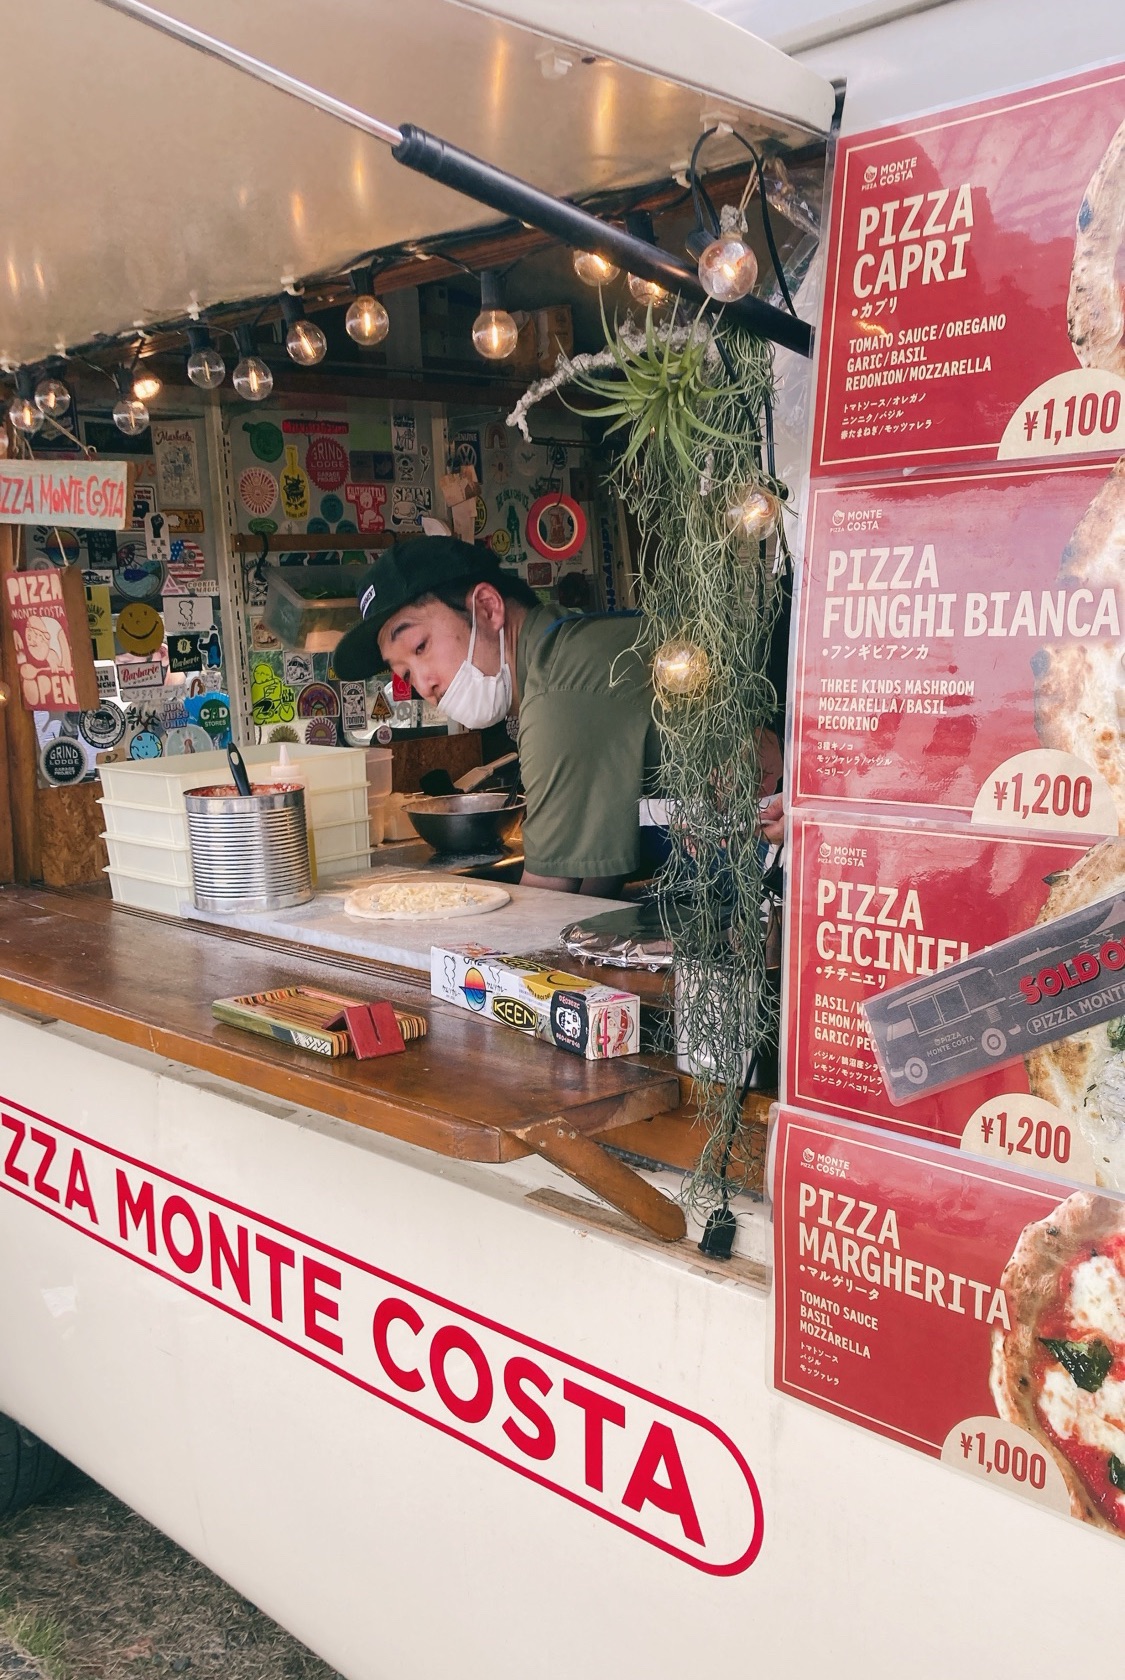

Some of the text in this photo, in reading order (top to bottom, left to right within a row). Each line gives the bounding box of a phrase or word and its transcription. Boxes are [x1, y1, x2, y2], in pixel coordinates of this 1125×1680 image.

[880, 169, 913, 187] COSTA
[881, 156, 918, 175] MONTE
[861, 183, 877, 191] PIZZA
[857, 183, 974, 251] PIZZA
[852, 232, 971, 299] CAPRI
[849, 313, 1007, 355] TOMATO SAUCE/OREGANO
[847, 346, 928, 373] GARIC/BASIL
[845, 355, 992, 392] REDONION/MOZZARELLA
[1023, 389, 1122, 446] ¥1,100
[312, 443, 344, 461] GRIND
[0, 474, 125, 518] ZZA MONTE COSTA
[847, 509, 883, 521] MONTE
[847, 520, 879, 532] COSTA
[826, 544, 939, 592] PIZZA
[6, 573, 63, 606] PIZZA
[11, 606, 66, 620] MONTE COSTA
[822, 588, 1121, 639] FUNGHI BIANCA
[22, 674, 78, 706] OPEN
[820, 678, 975, 696] THREE KINDS MASHROOM
[160, 711, 189, 721] VIBES
[163, 703, 185, 712] BBQ
[818, 697, 948, 715] MOZZARELLA/BASIL
[817, 715, 879, 732] PECORINO
[49, 745, 79, 760] GRIND
[993, 772, 1094, 820] ¥1,200
[834, 846, 868, 858] MONTE
[834, 856, 865, 868] COSTA
[816, 879, 924, 931] PIZZA
[1018, 936, 1125, 1005] SOLD O
[494, 1001, 536, 1025] KEEN
[1032, 1005, 1078, 1033] PIZZA
[926, 1034, 975, 1058] MONTE COSTA
[941, 1031, 962, 1044] PIZZA
[980, 1111, 1072, 1164] ¥1,200
[816, 1163, 846, 1179] COSTA
[817, 1153, 850, 1170] MONTE
[799, 1182, 901, 1250] PIZZA
[799, 1222, 1012, 1332] MARGHERITA
[800, 1289, 879, 1331] TOMATO SAUCE
[800, 1304, 833, 1329] BASIL
[800, 1319, 871, 1360] MOZZARELLA
[116, 1167, 344, 1356] MONTE
[372, 1296, 707, 1549] COSTA
[960, 1431, 1047, 1491] ¥1,000
